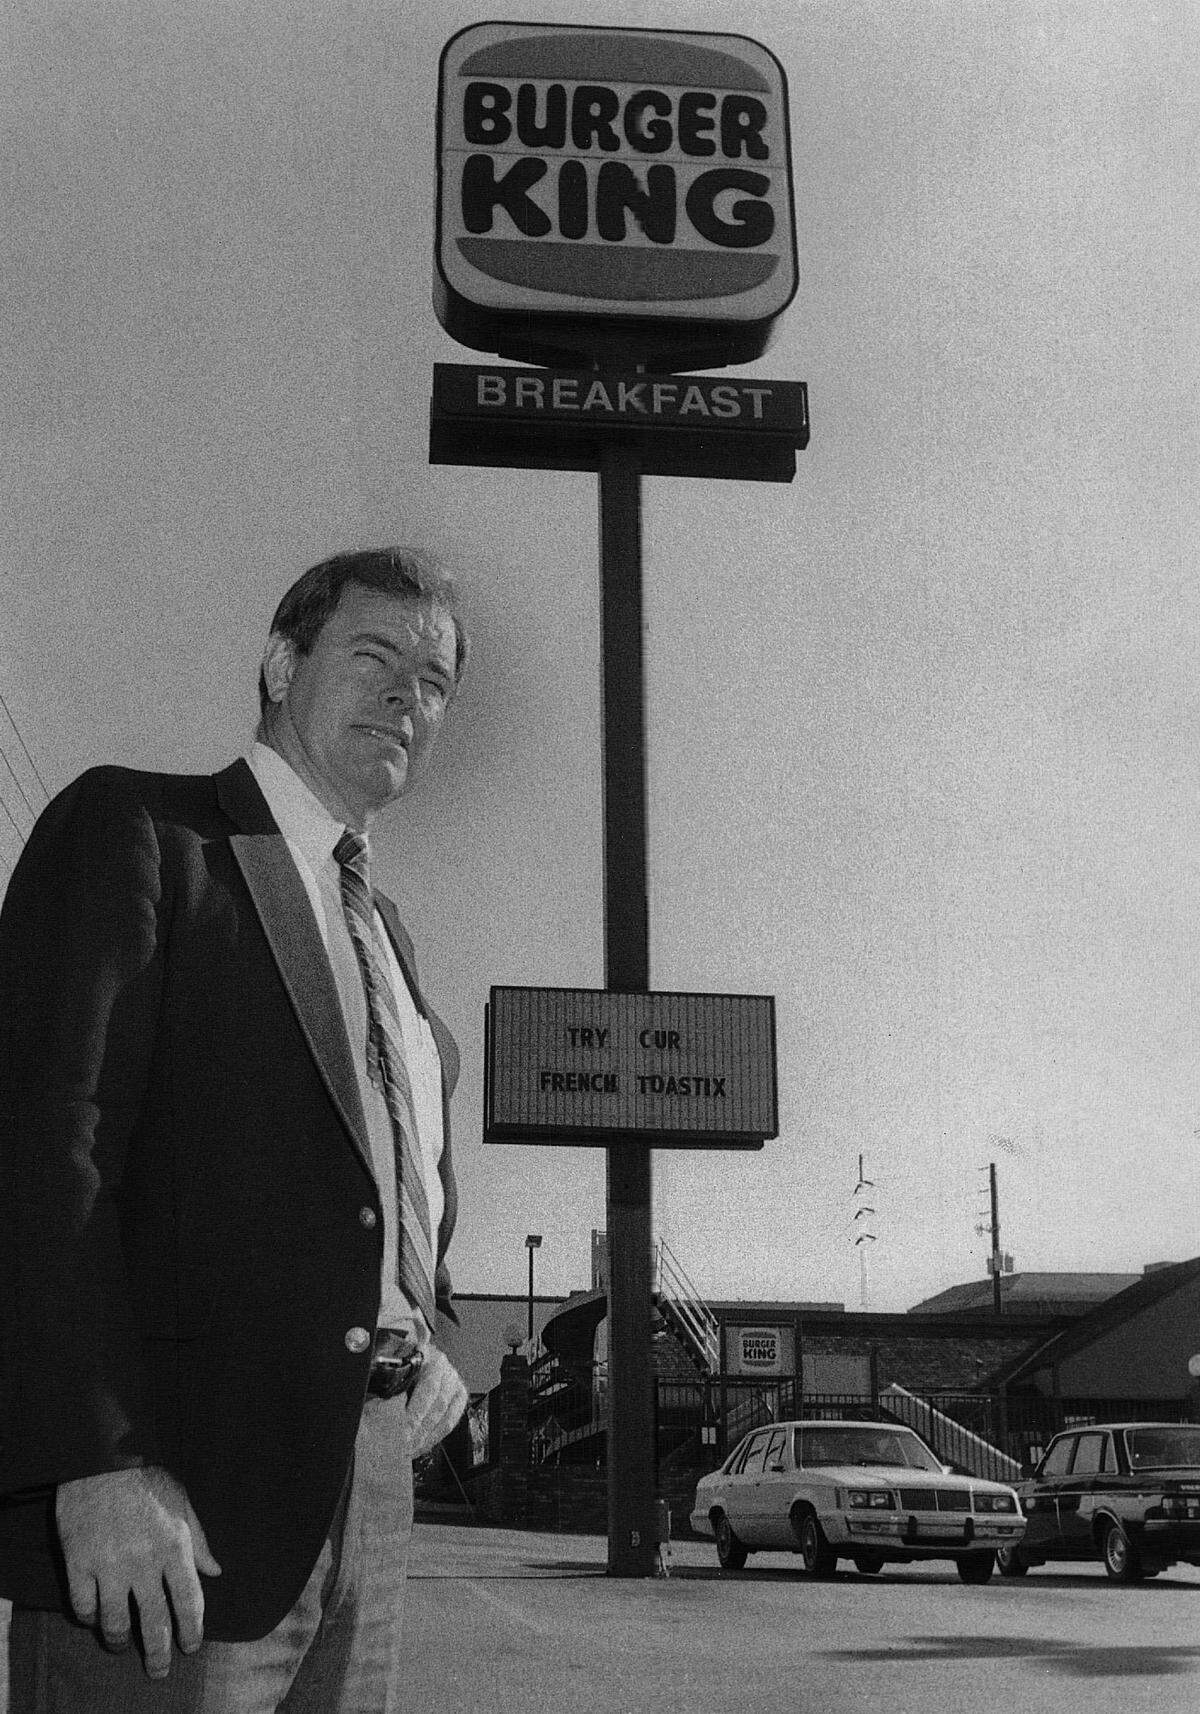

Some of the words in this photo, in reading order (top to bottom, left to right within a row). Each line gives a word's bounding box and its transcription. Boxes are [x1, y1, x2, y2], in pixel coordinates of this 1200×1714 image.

[462, 81, 770, 161] BURGER
[461, 153, 776, 249] KING
[476, 374, 773, 420] BREAKFAST
[568, 1027, 607, 1049] TRY
[540, 1071, 618, 1094] FRENCH
[637, 1074, 727, 1097] TOASTIX
[742, 1340, 776, 1348] BURGER
[743, 1348, 776, 1360] KING
